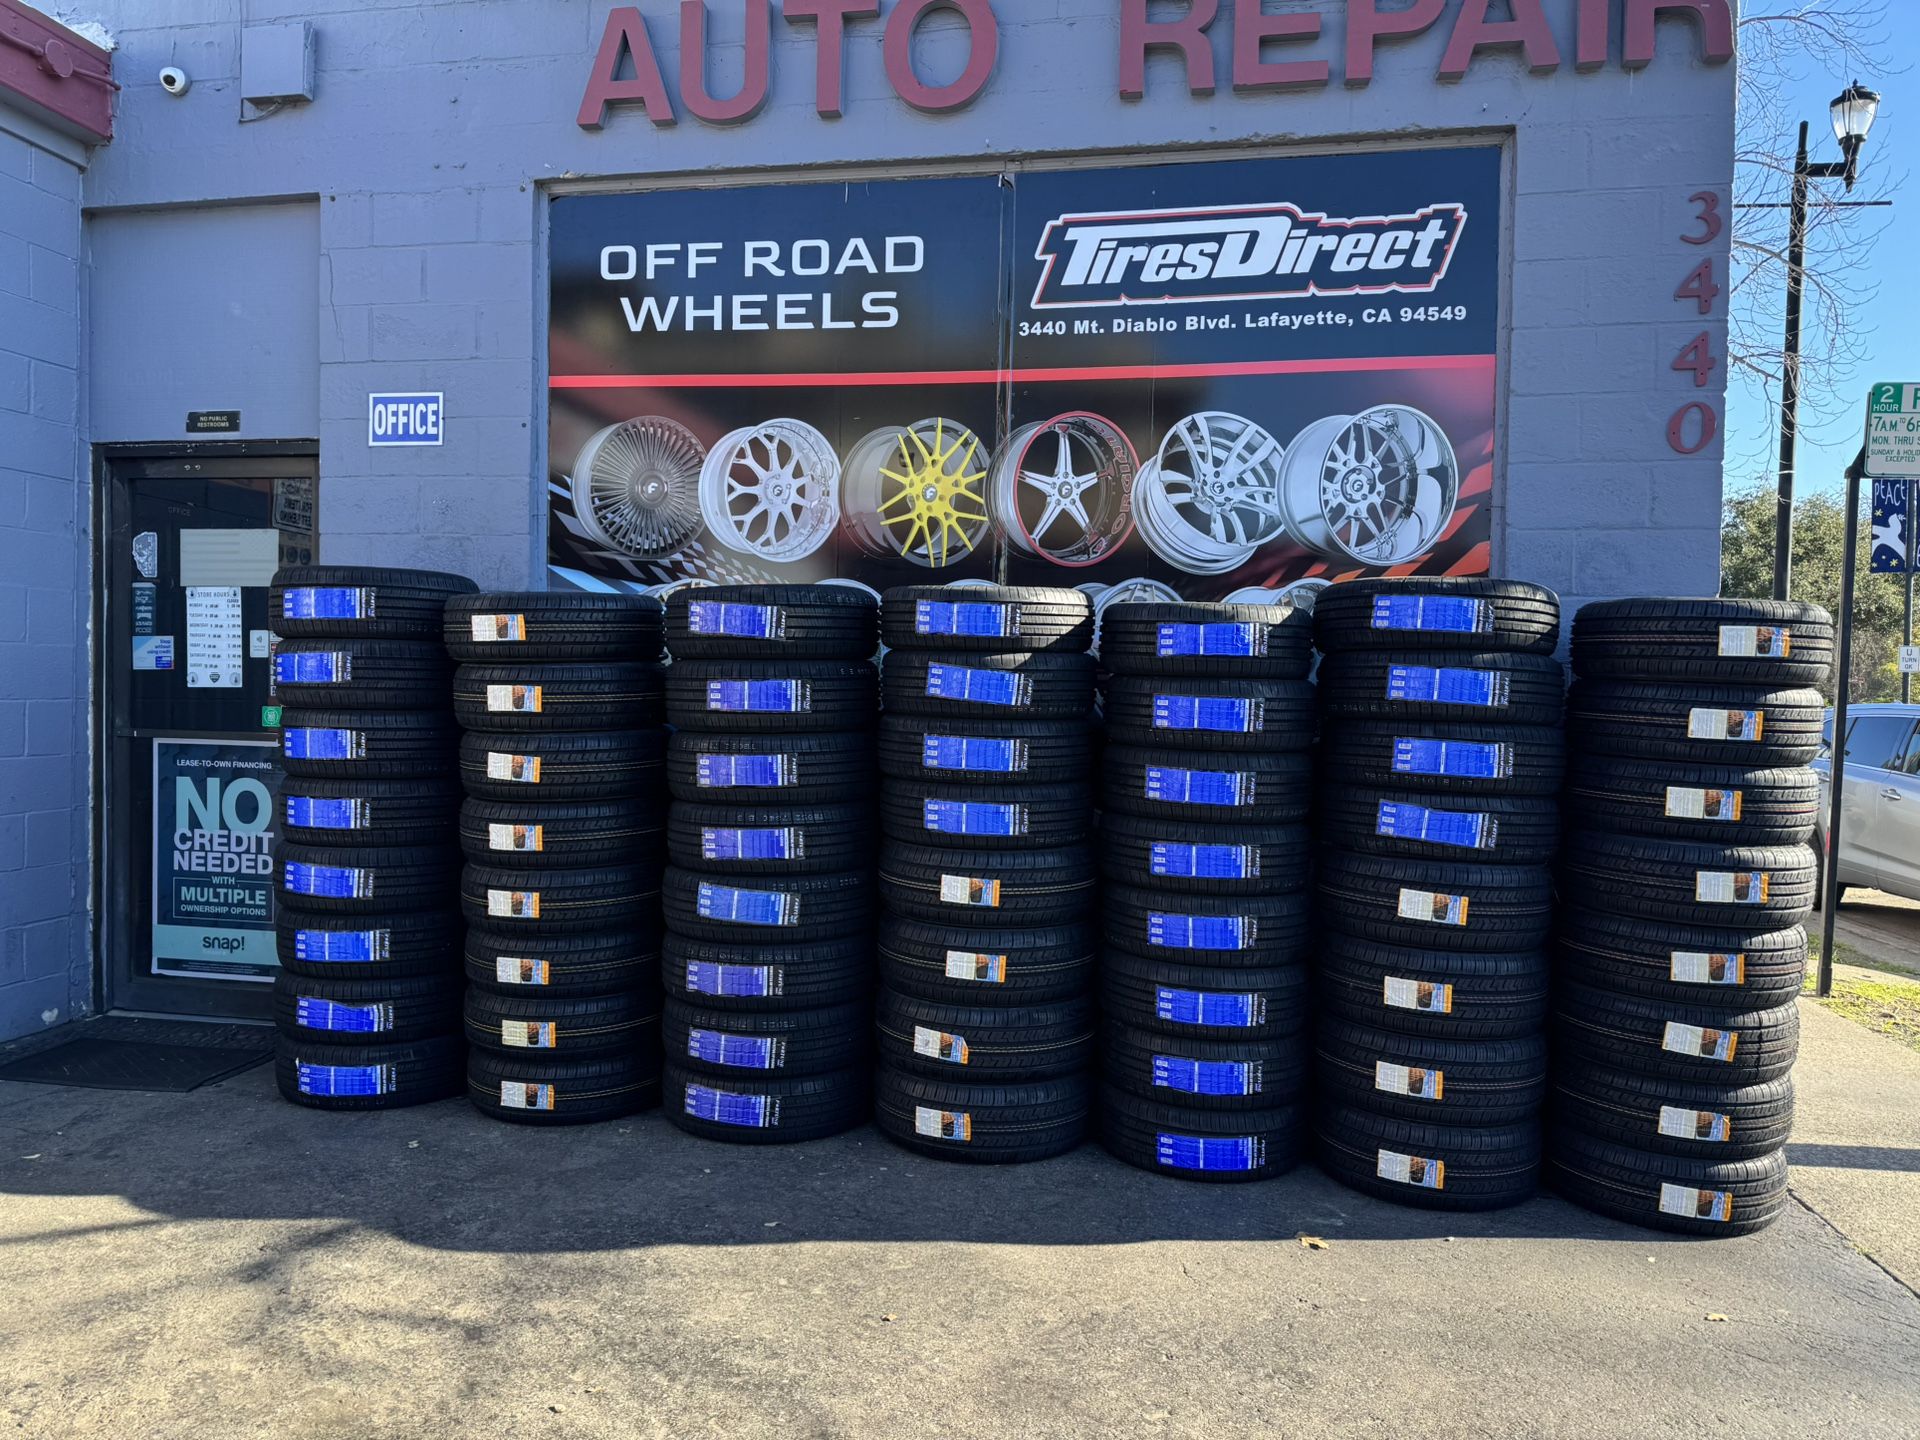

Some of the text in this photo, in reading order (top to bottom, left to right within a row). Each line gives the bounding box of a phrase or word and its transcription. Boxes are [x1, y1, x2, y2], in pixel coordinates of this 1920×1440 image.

[576, 0, 1734, 130] AUTO REPAIR
[600, 235, 925, 281] OFF ROAD
[1060, 216, 1447, 286] TiresDirect
[619, 291, 900, 332] WHEELS
[1018, 305, 1467, 337] 3440 Mt. Diablo Blvd. Lafayette, CA 94549
[1880, 385, 1894, 403] 2
[373, 403, 439, 436] OFFICE
[1872, 404, 1899, 412] HOUR
[1894, 436, 1914, 446] THRU
[176, 759, 272, 770] LEASE-TO-OWN FINANCING
[175, 775, 273, 833] NO
[173, 828, 275, 854] CREDIT
[173, 850, 274, 875] NEEDED
[211, 876, 236, 886] WITH
[180, 886, 267, 905] MULTIPLE
[180, 904, 267, 916] OWNERSHIP OPTIONS
[202, 936, 245, 954] snap!
